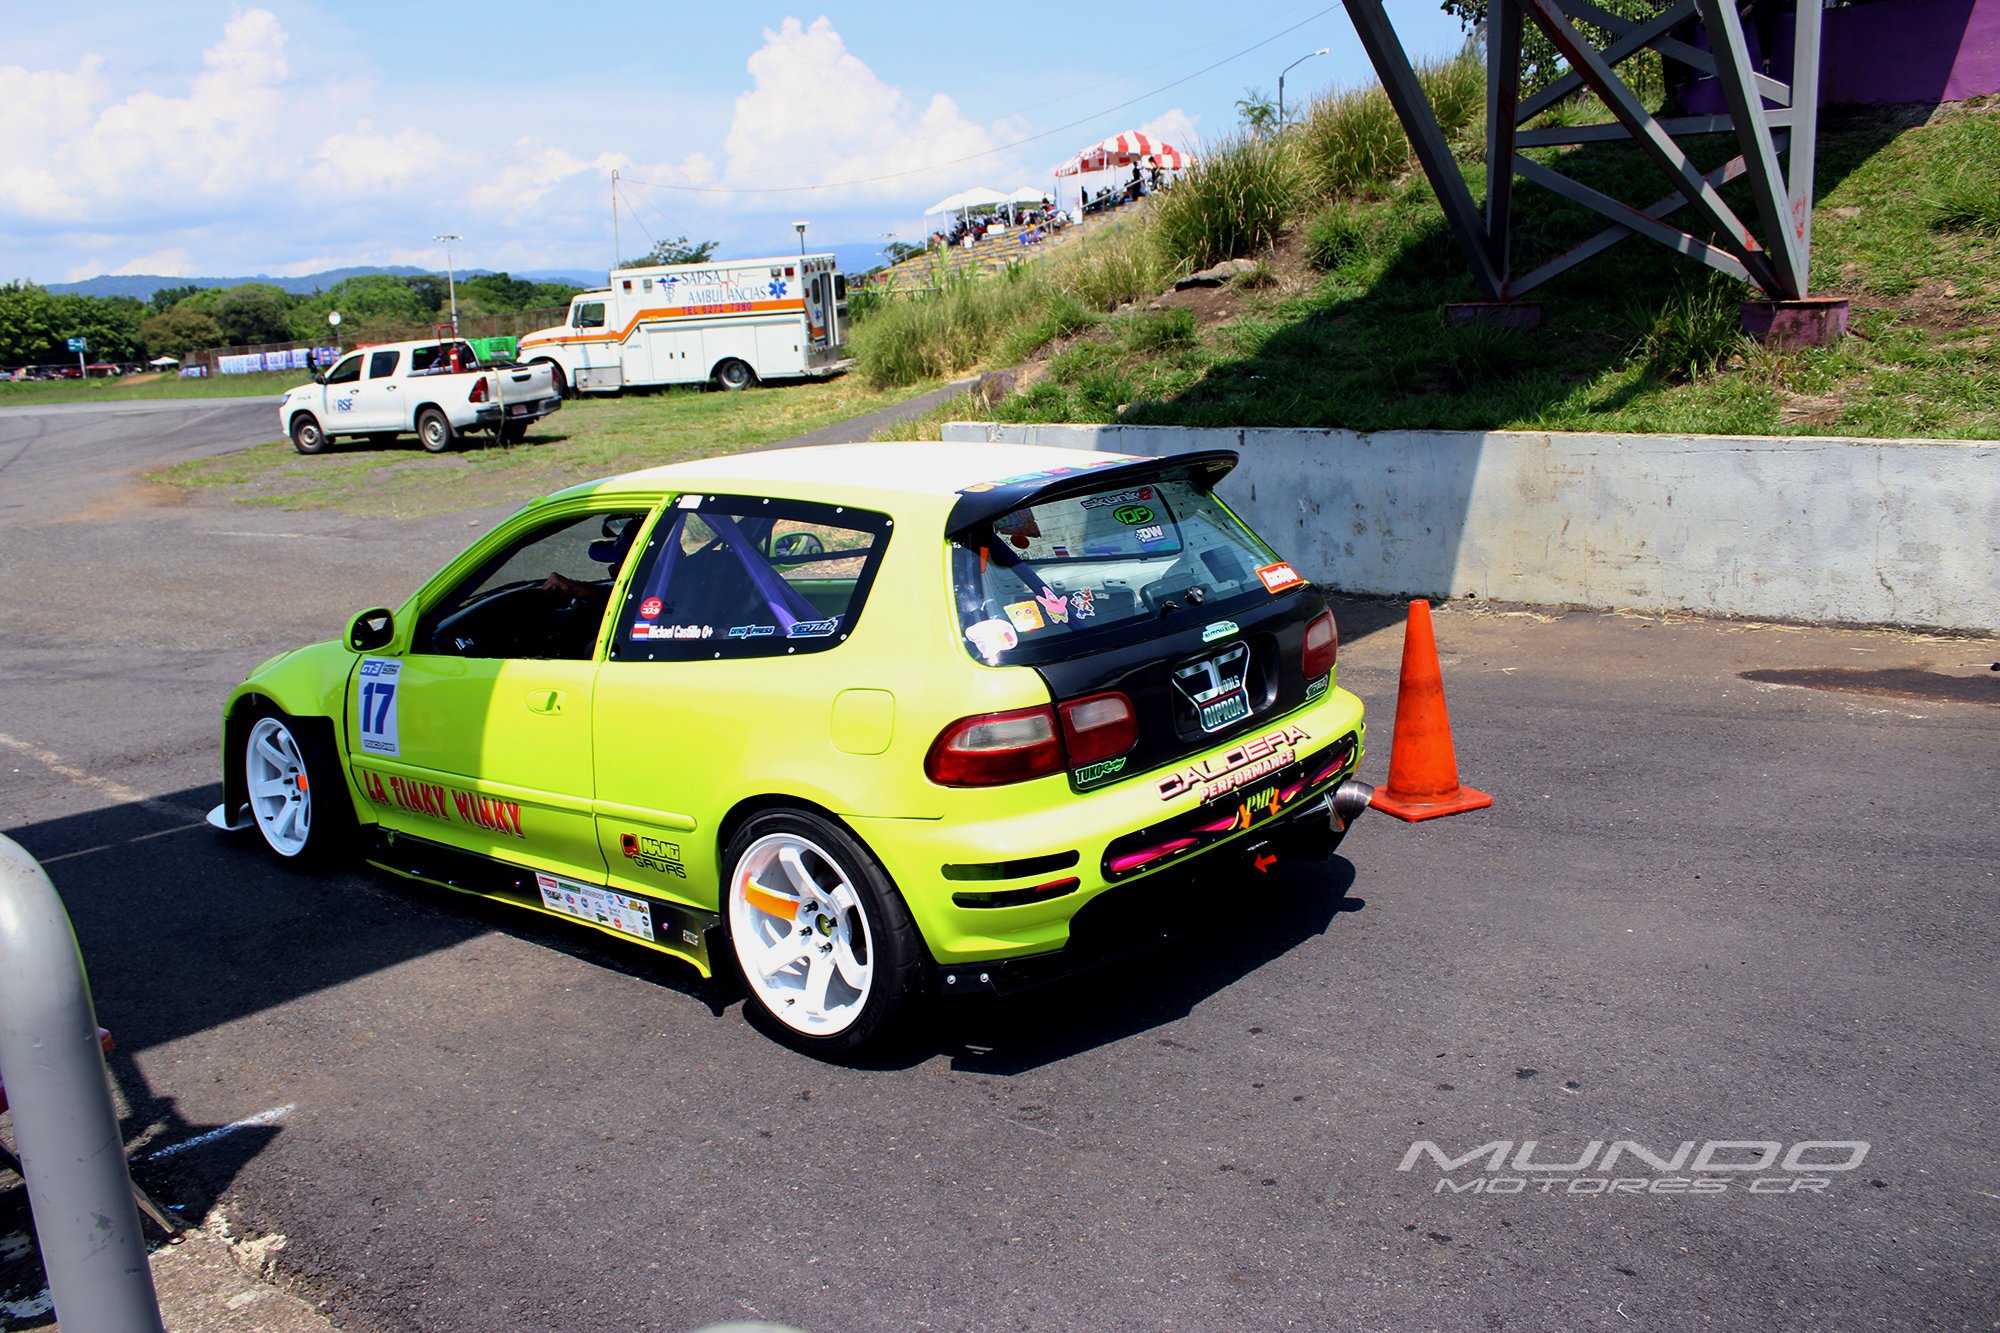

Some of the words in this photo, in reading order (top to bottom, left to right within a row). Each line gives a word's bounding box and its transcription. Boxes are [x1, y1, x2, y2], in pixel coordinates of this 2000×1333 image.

[681, 270, 720, 285] SAPSA
[688, 285, 767, 304] AMBULANCIAS
[682, 306, 698, 316] TEL
[674, 625, 702, 639] Castillo
[361, 663, 382, 674] GT3
[362, 682, 396, 735] 17
[1203, 695, 1245, 727] DIPROA
[1155, 725, 1311, 801] CALDERA
[1200, 749, 1295, 802] PERFORMANCE
[362, 769, 392, 806] LA
[451, 788, 526, 840] WINKY
[633, 855, 687, 879] GRUAS
